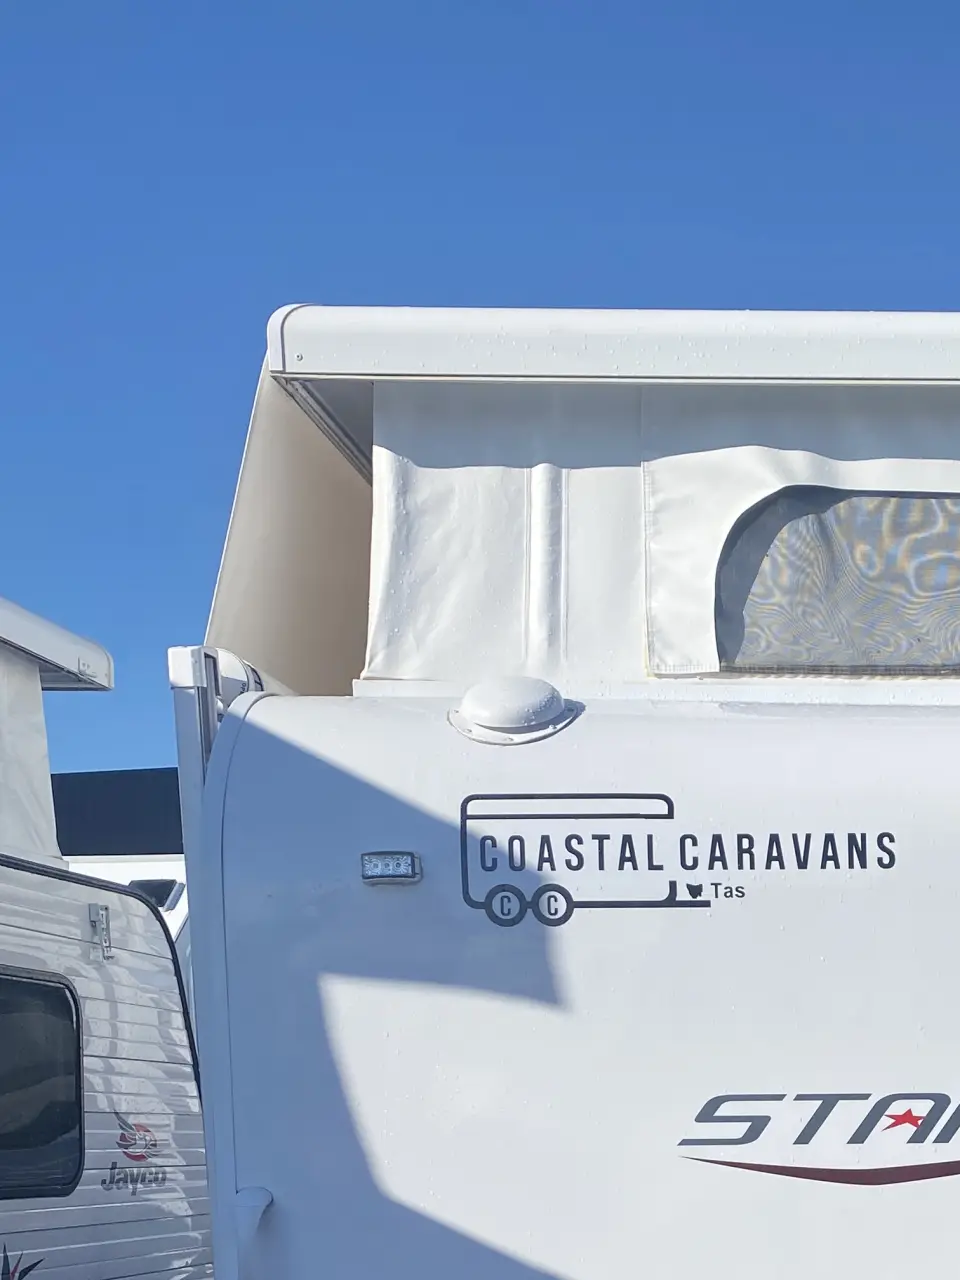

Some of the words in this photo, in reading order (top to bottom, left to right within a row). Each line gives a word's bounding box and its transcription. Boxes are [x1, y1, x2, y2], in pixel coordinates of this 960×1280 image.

[479, 833, 664, 872] COASTAL
[679, 831, 897, 871] CARAVANS
[711, 882, 746, 899] Tas
[500, 895, 512, 917] C
[547, 894, 559, 916] C
[101, 1161, 167, 1197] Jayco
